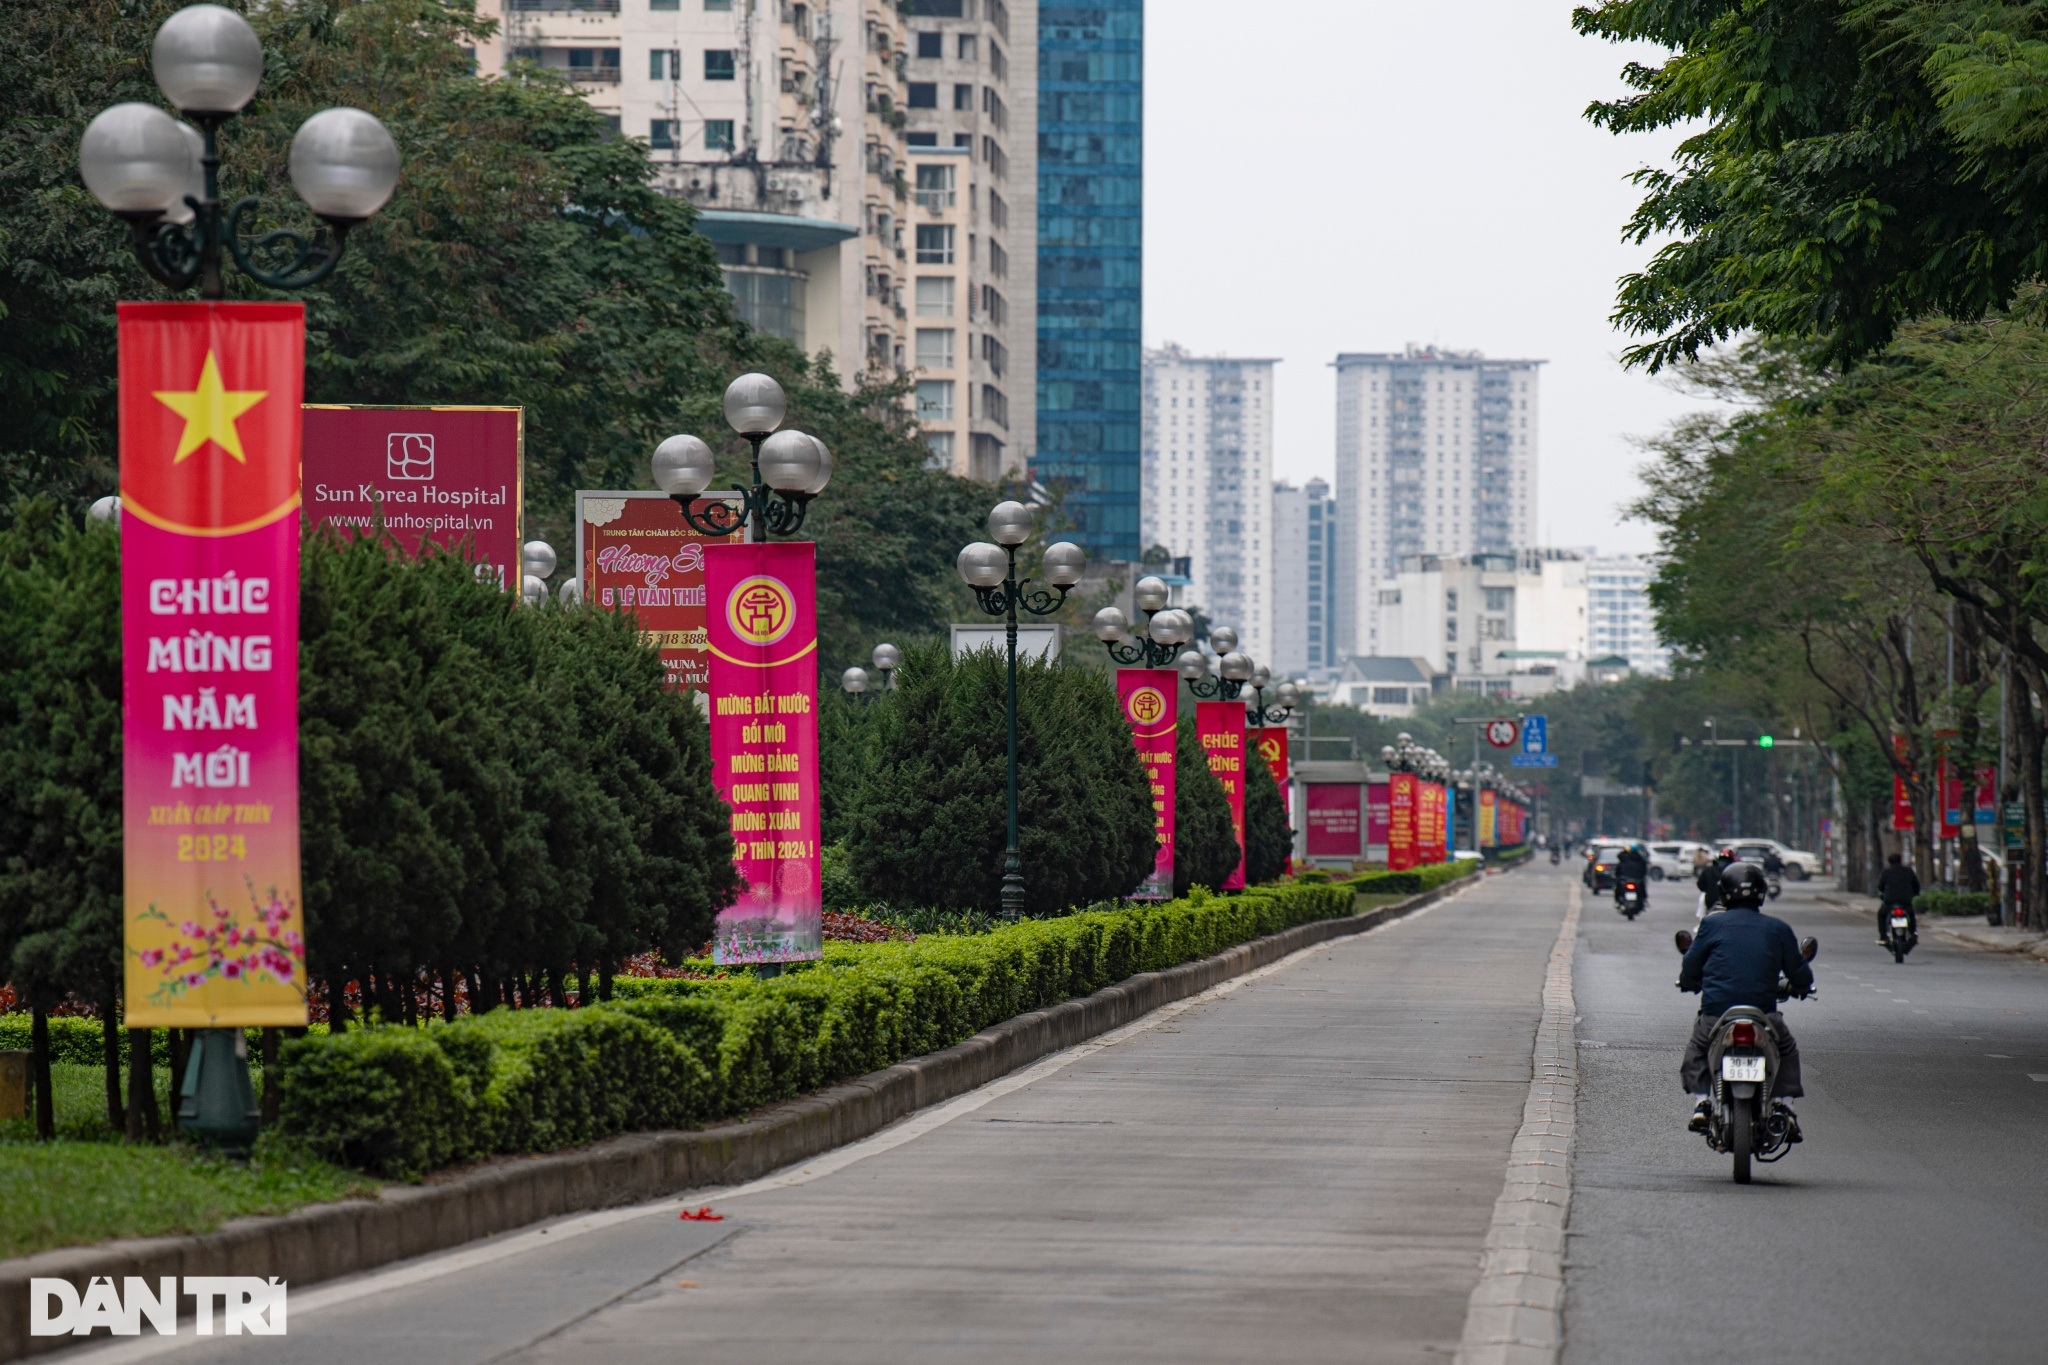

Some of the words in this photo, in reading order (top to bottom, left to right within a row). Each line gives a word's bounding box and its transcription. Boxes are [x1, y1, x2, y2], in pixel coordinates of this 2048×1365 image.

[315, 483, 354, 502] Sun
[358, 484, 417, 503] Korea
[422, 485, 506, 509] Hospital
[328, 513, 493, 533] www.unhospital.vn
[603, 529, 627, 537] TRUNG
[628, 528, 644, 537] TÂM
[645, 528, 669, 537] CHĂM
[597, 543, 670, 585] Hương
[149, 569, 270, 615] CHÚC
[602, 588, 613, 606] 5
[617, 585, 635, 606] LÊ
[638, 584, 670, 606] VĂN
[146, 628, 273, 673] MỪNG
[661, 659, 697, 669] SAUNA
[162, 686, 258, 731] NĂM
[717, 693, 752, 715] MỪNG
[754, 689, 775, 714] ĐẤT
[778, 691, 810, 714] NƯỚC
[742, 718, 761, 744] ĐỔI
[764, 720, 786, 743] MỚI
[1202, 730, 1239, 749] CHÚC
[171, 743, 250, 788] MỚI
[731, 751, 765, 773] MỪNG
[767, 748, 799, 772] ĐẢNG
[732, 783, 769, 804] QUANG
[772, 782, 799, 801] VINH
[733, 809, 766, 831] MỪNG
[769, 808, 800, 830] XUÂN
[177, 834, 247, 862] 2024
[750, 837, 775, 860] THÌN
[778, 841, 806, 859] 2024
[1730, 1069, 1759, 1079] 9617
